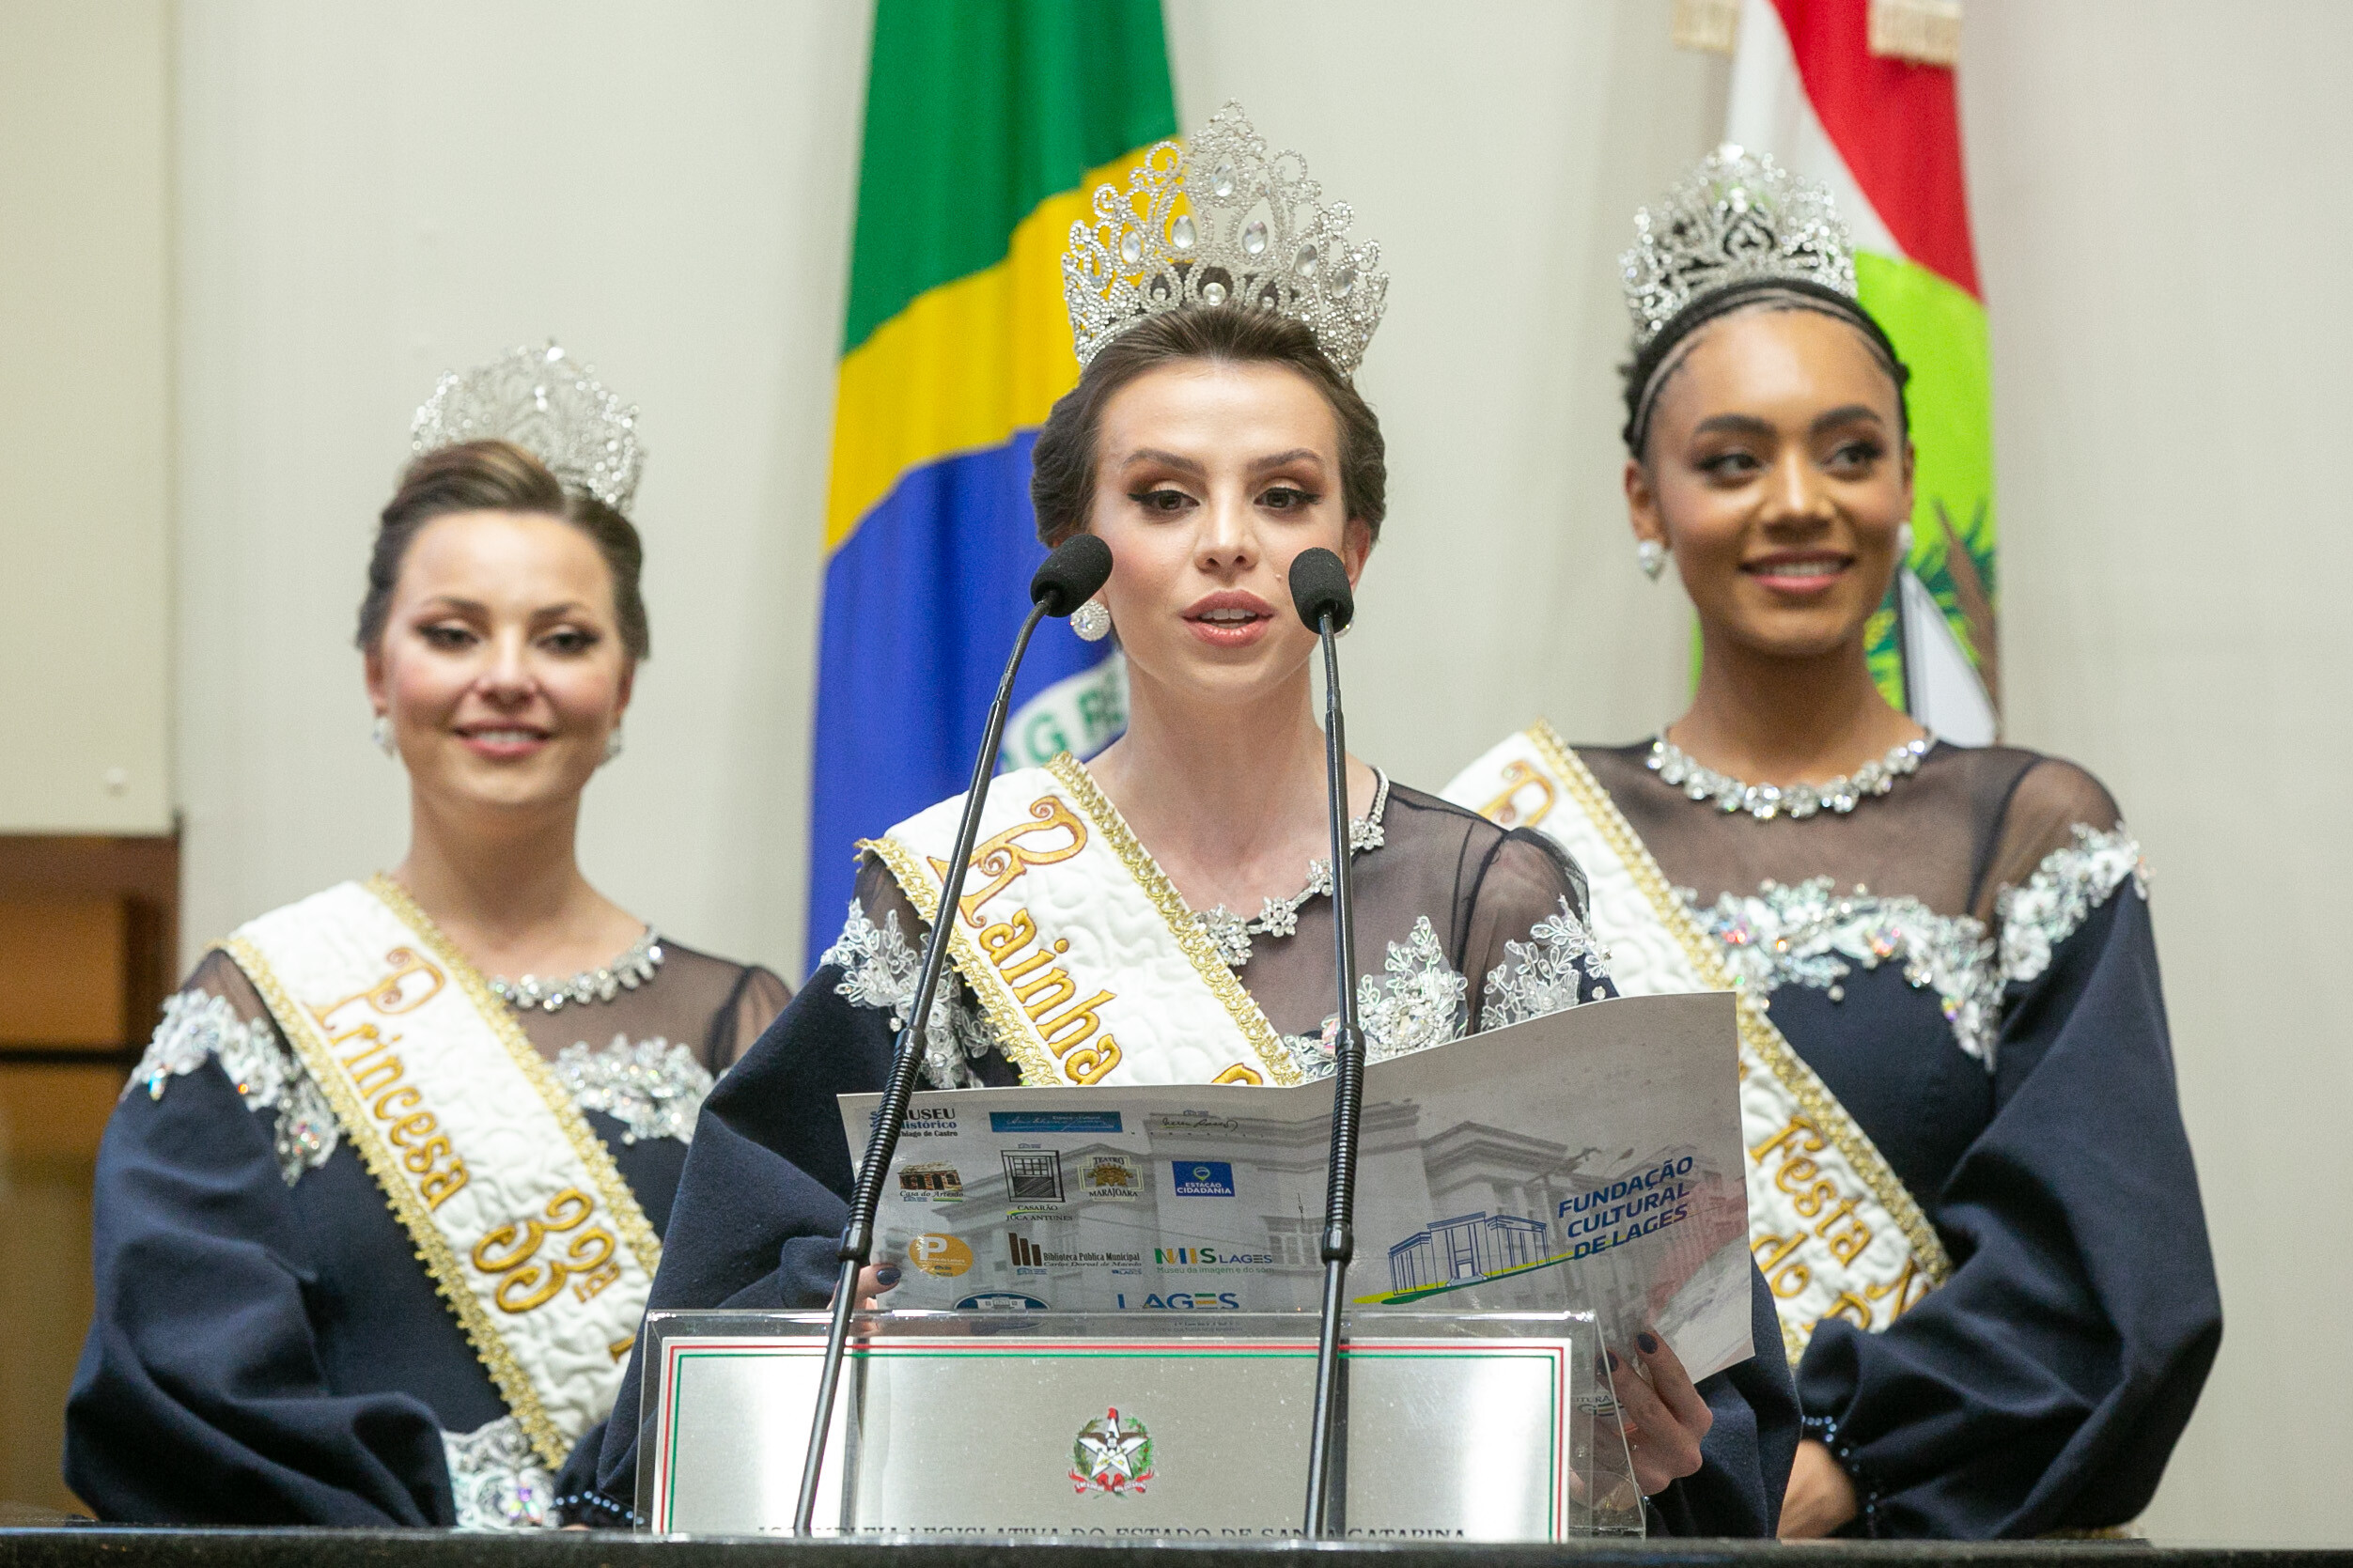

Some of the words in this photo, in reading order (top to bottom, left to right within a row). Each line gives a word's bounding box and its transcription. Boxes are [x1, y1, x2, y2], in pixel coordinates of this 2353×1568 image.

[927, 795, 1124, 1085] Rainha
[302, 946, 469, 1211] Princesa
[902, 1108, 956, 1120] USEU
[1093, 1157, 1125, 1165] TEATRO
[1089, 1188, 1139, 1198] MARAJOARA
[1559, 1156, 1693, 1219] FUNDAÇÃO
[1749, 1114, 1873, 1268] Festa
[1567, 1182, 1690, 1238] CULTURAL
[1574, 1234, 1607, 1260] DE
[1612, 1203, 1689, 1248] LAGES
[918, 1236, 948, 1260] P
[1043, 1252, 1078, 1261] Biblioteca
[1079, 1252, 1105, 1261] Pública
[1106, 1252, 1140, 1263] Municipal
[1219, 1254, 1273, 1264] LAGES
[1199, 1266, 1234, 1275] imagem
